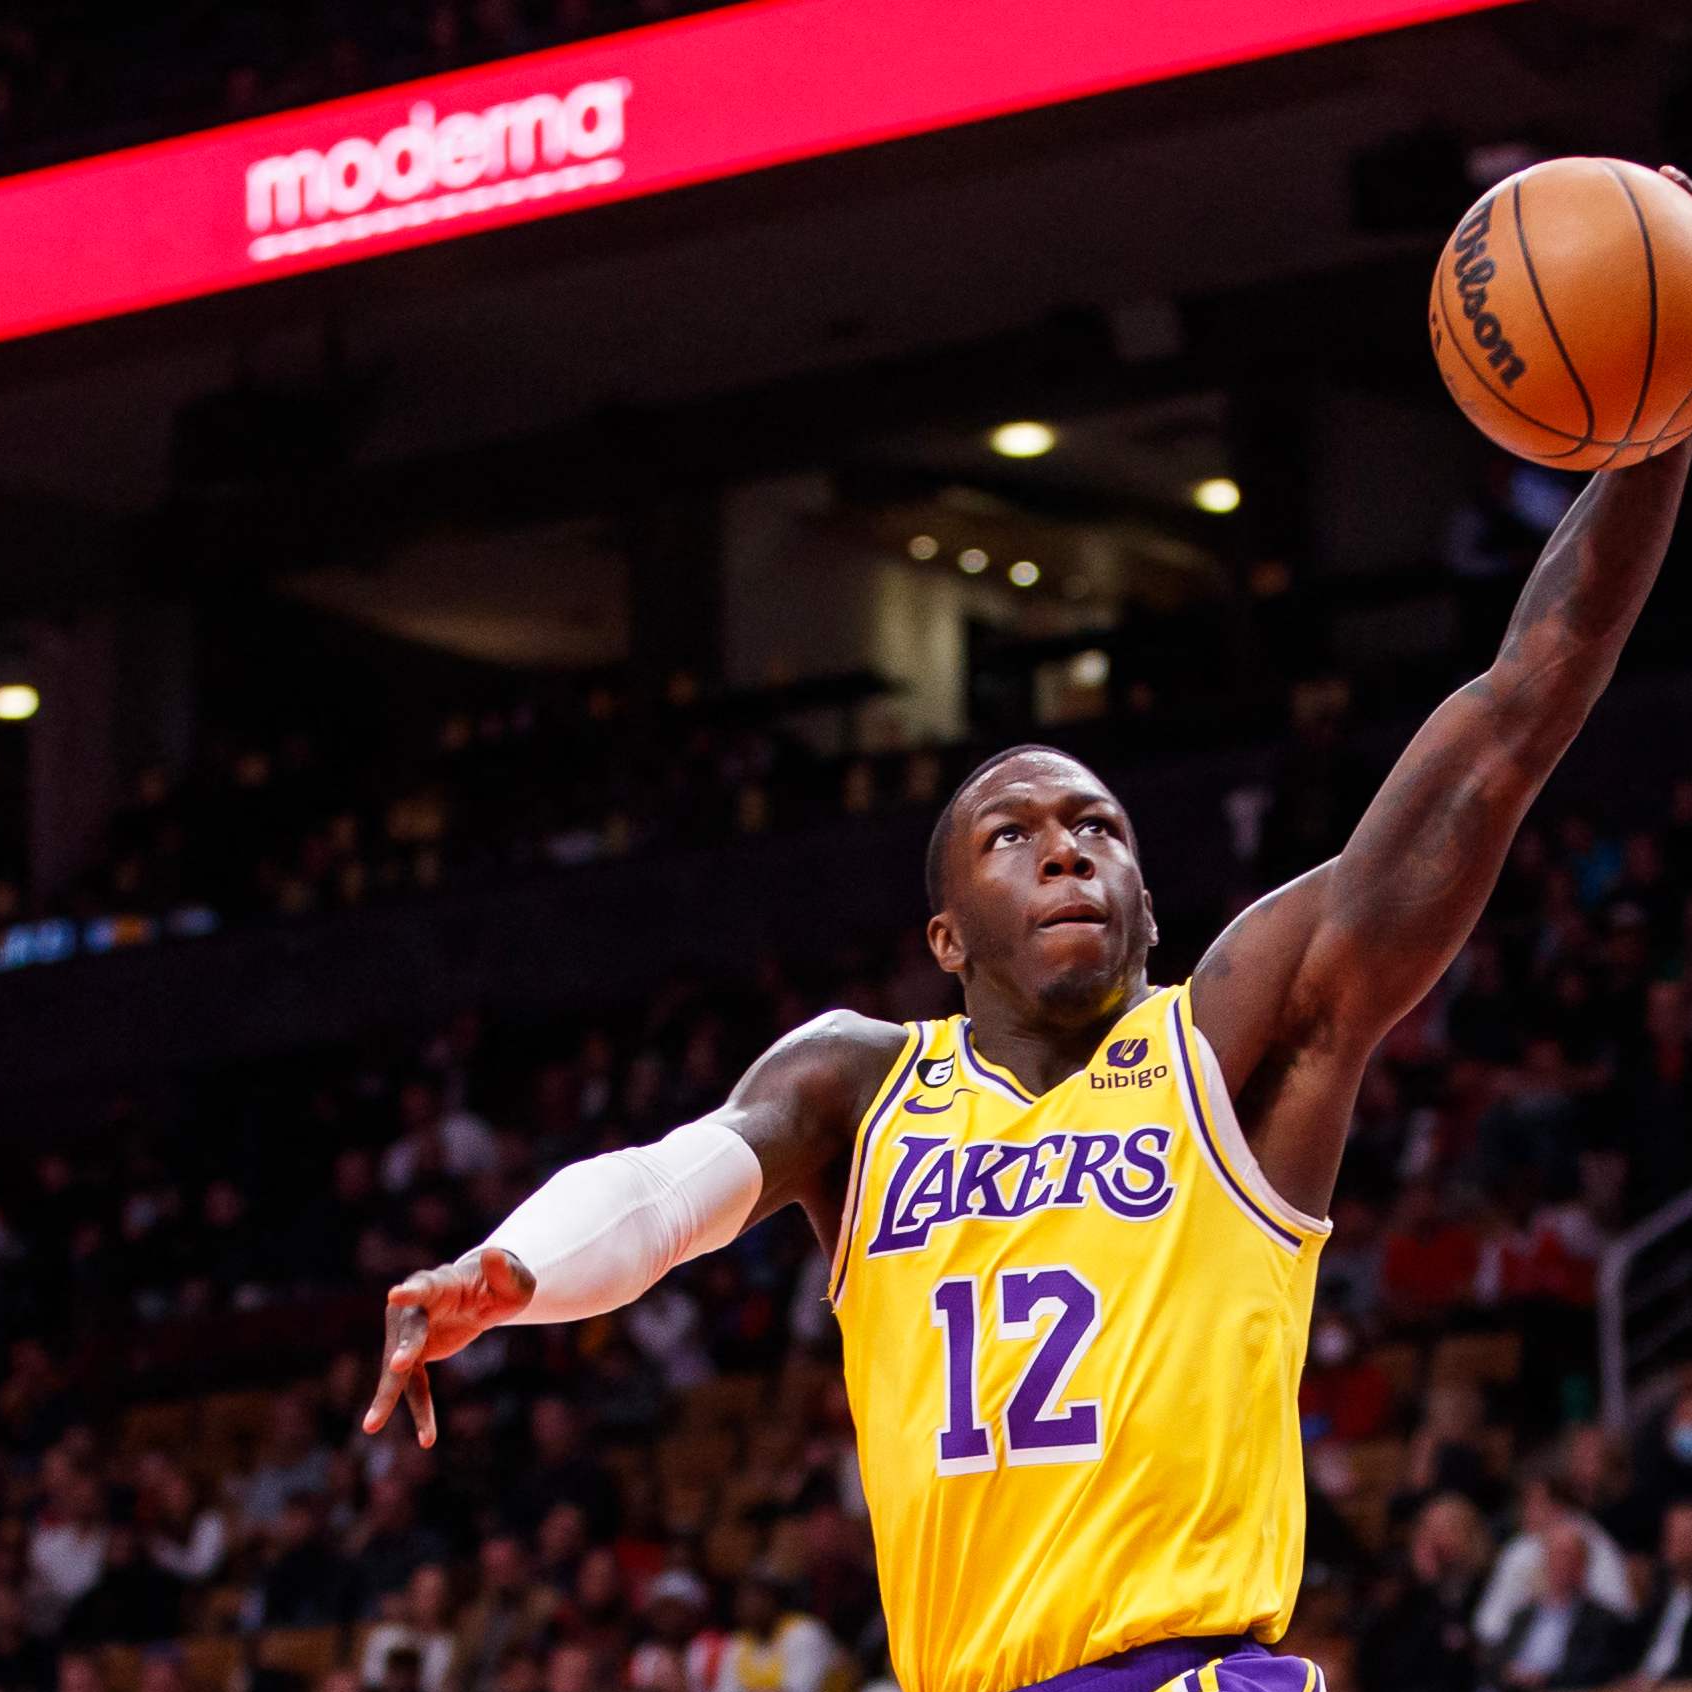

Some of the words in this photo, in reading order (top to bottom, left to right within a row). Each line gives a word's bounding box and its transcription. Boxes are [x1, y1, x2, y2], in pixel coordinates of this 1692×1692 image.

[246, 76, 633, 232] moderna
[1455, 196, 1526, 389] Wilson
[1089, 1064, 1168, 1091] bibigo
[866, 1126, 1178, 1260] LAKERS
[929, 1263, 1103, 1478] 12
